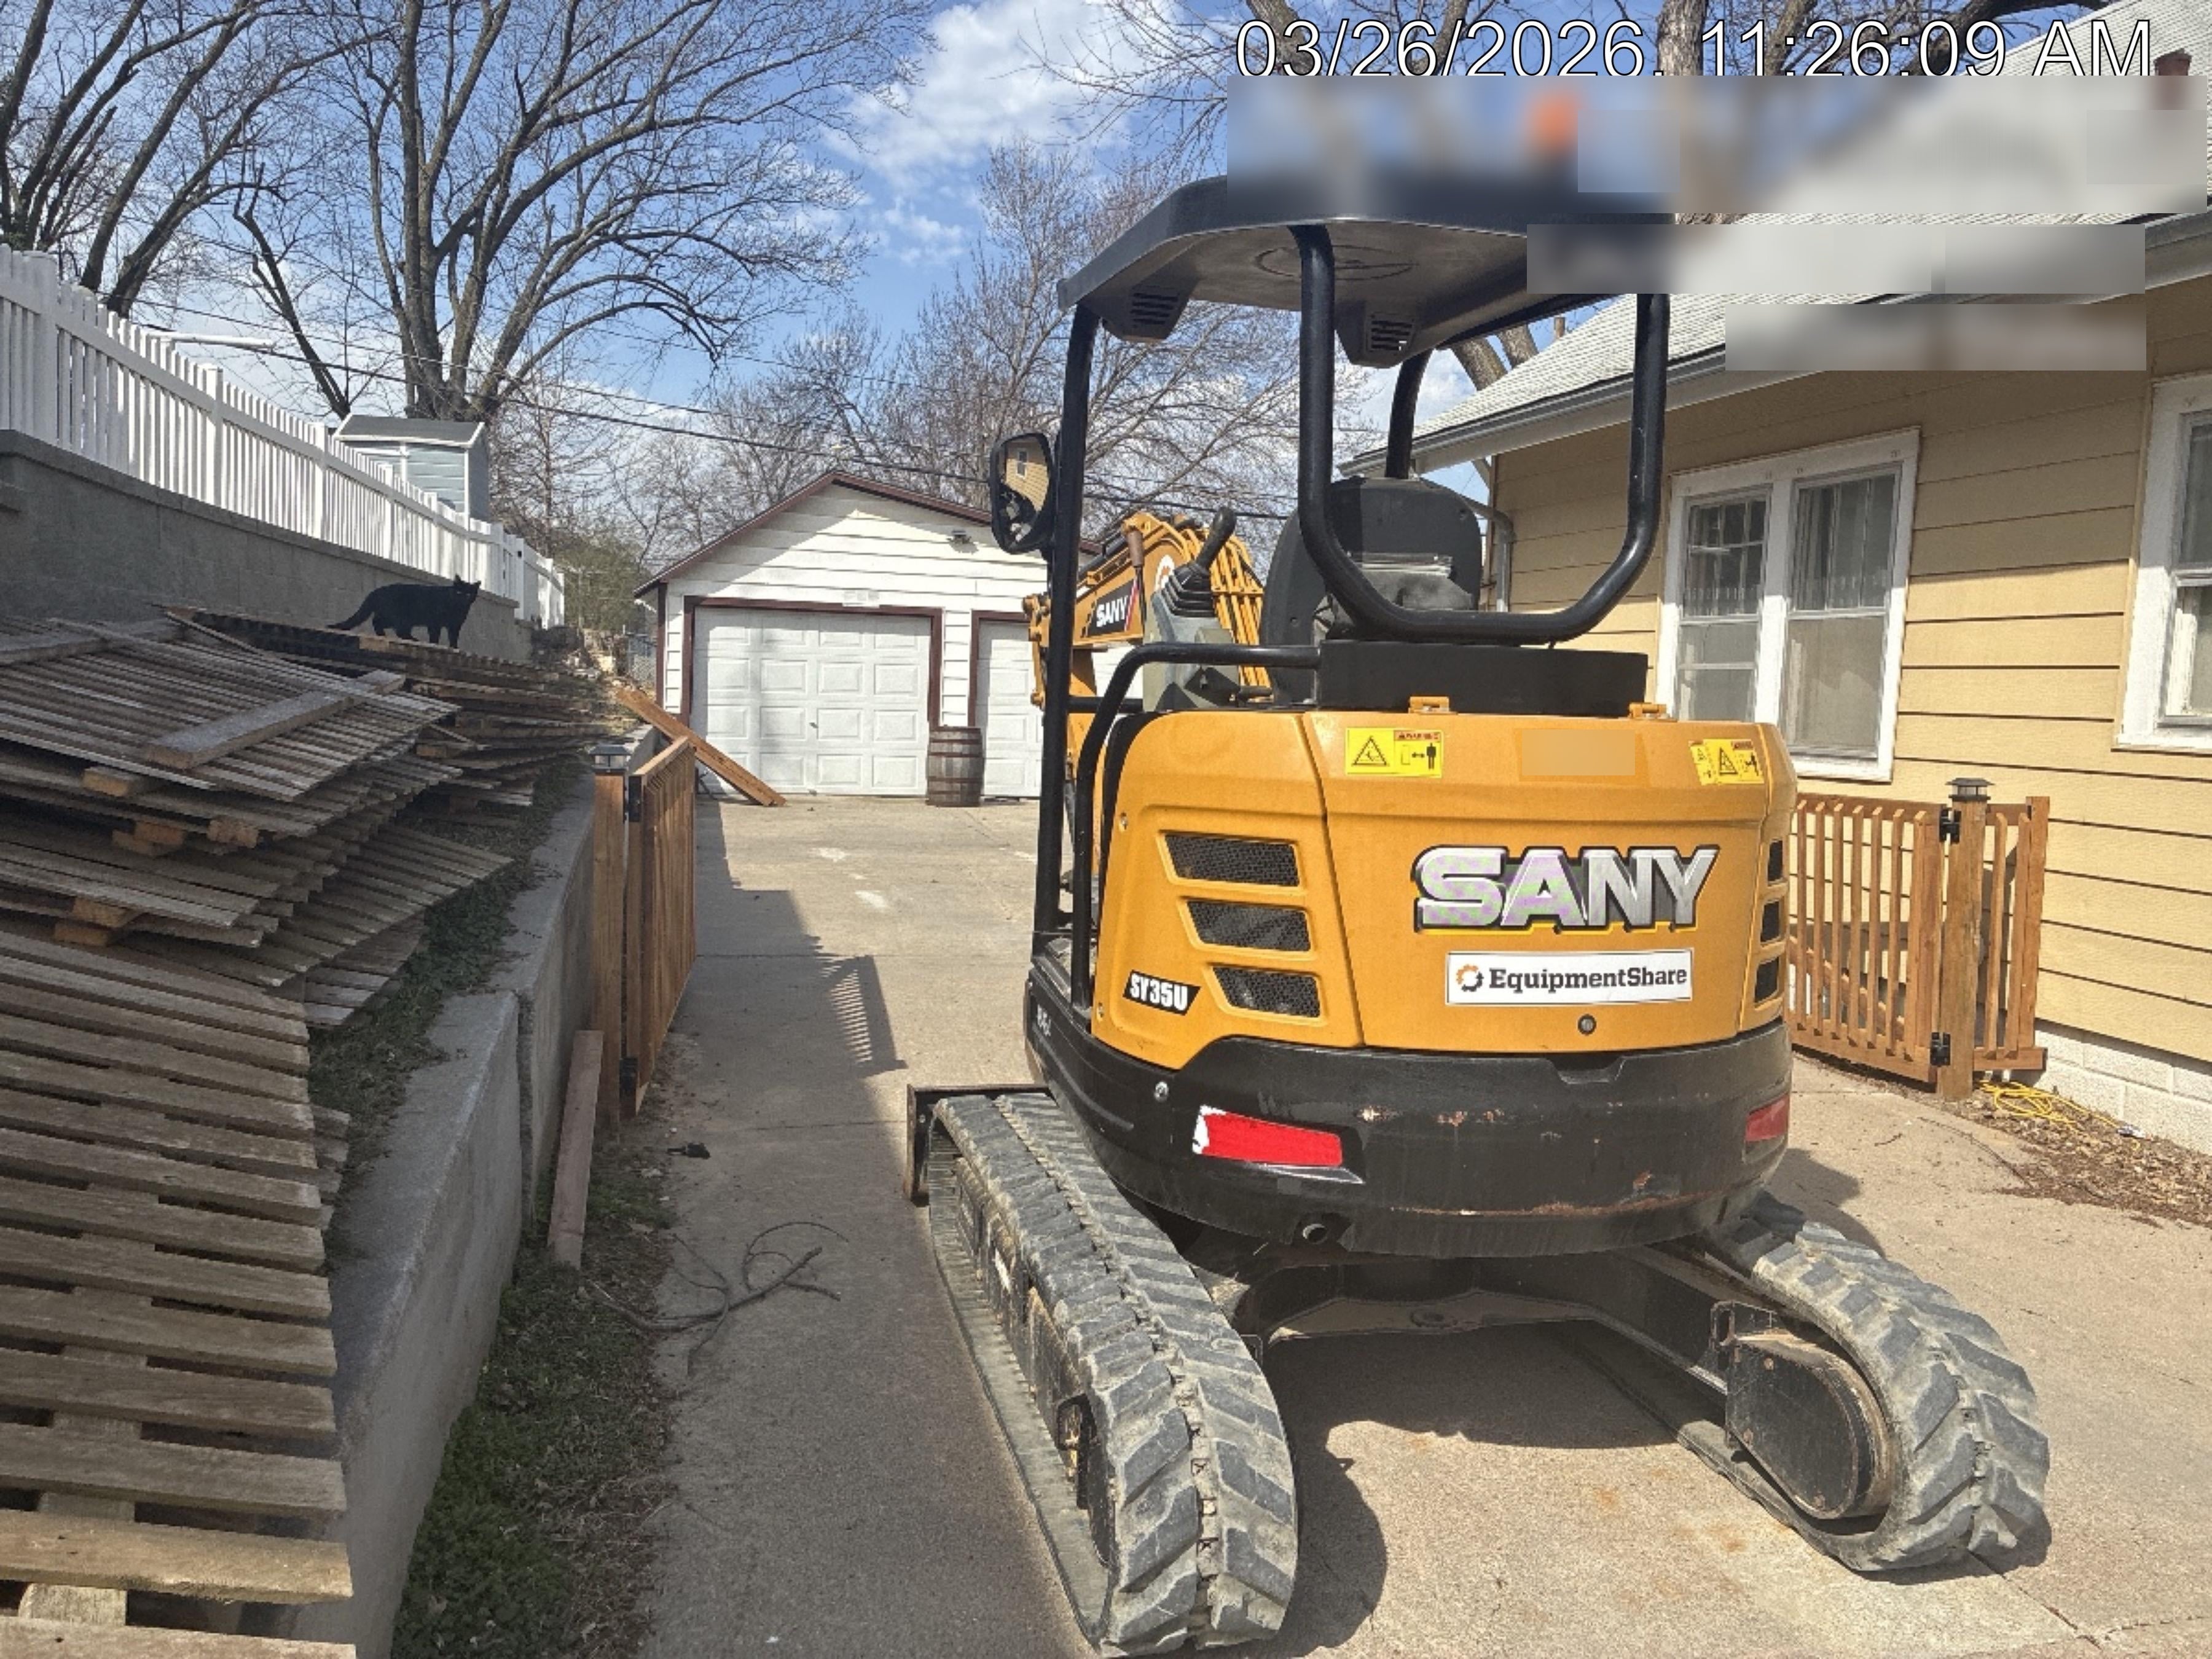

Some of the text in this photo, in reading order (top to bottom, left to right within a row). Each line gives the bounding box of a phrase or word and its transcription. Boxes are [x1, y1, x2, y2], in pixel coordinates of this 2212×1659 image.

[1096, 595, 1128, 627] SANY
[1411, 844, 1720, 933] SANY
[1129, 973, 1188, 1011] SY35U
[1488, 967, 1688, 994] EquipmentShare
